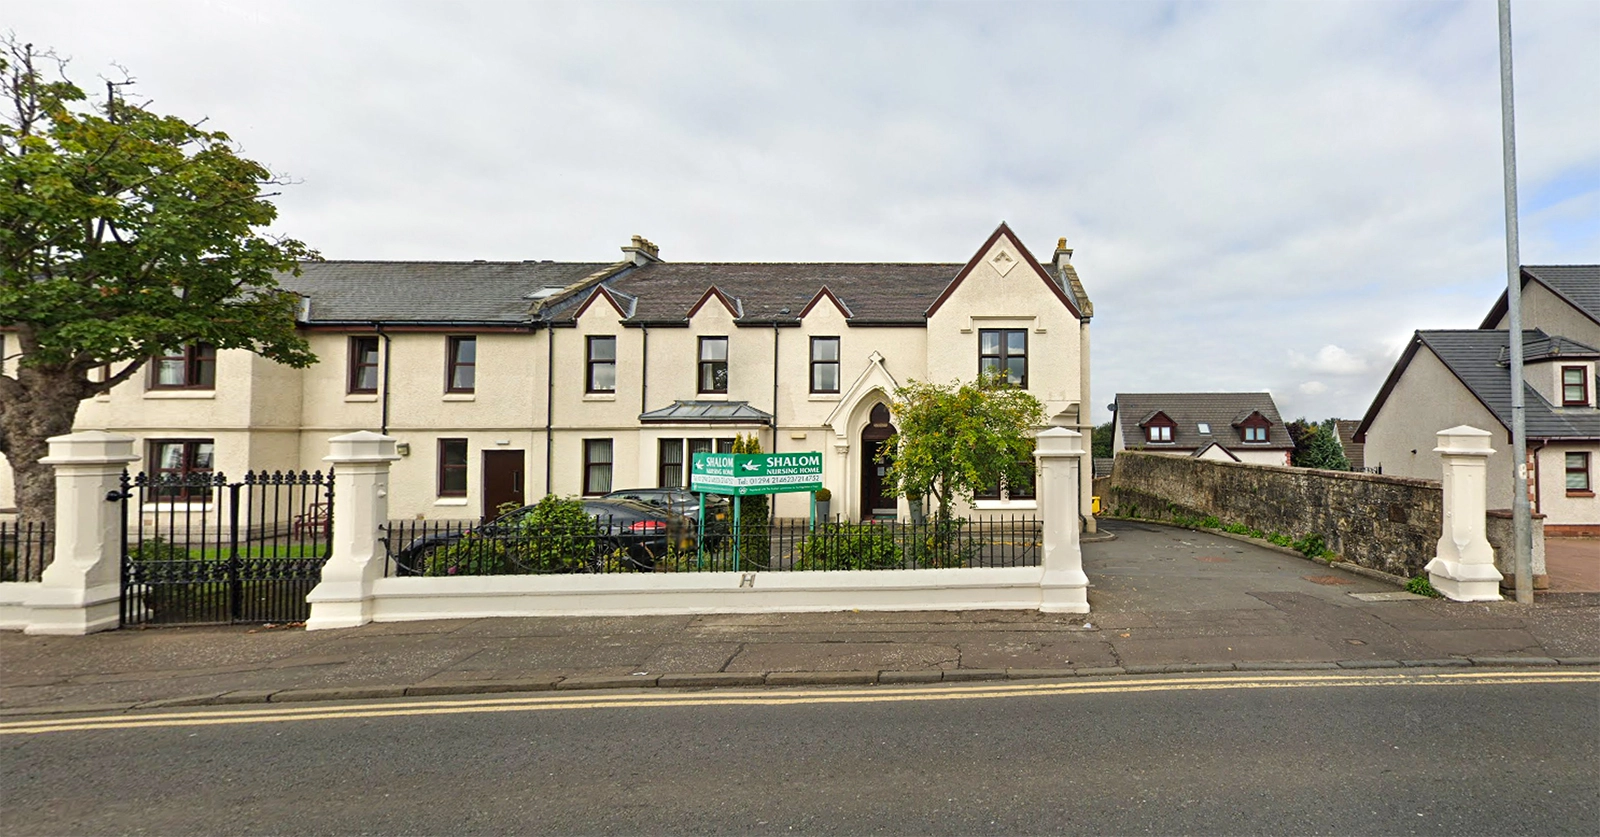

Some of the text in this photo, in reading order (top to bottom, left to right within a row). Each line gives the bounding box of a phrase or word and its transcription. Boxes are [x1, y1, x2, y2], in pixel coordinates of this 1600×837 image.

[706, 457, 734, 468] SHALOM
[766, 456, 820, 468] SHALOM
[749, 477, 770, 485] 01294
